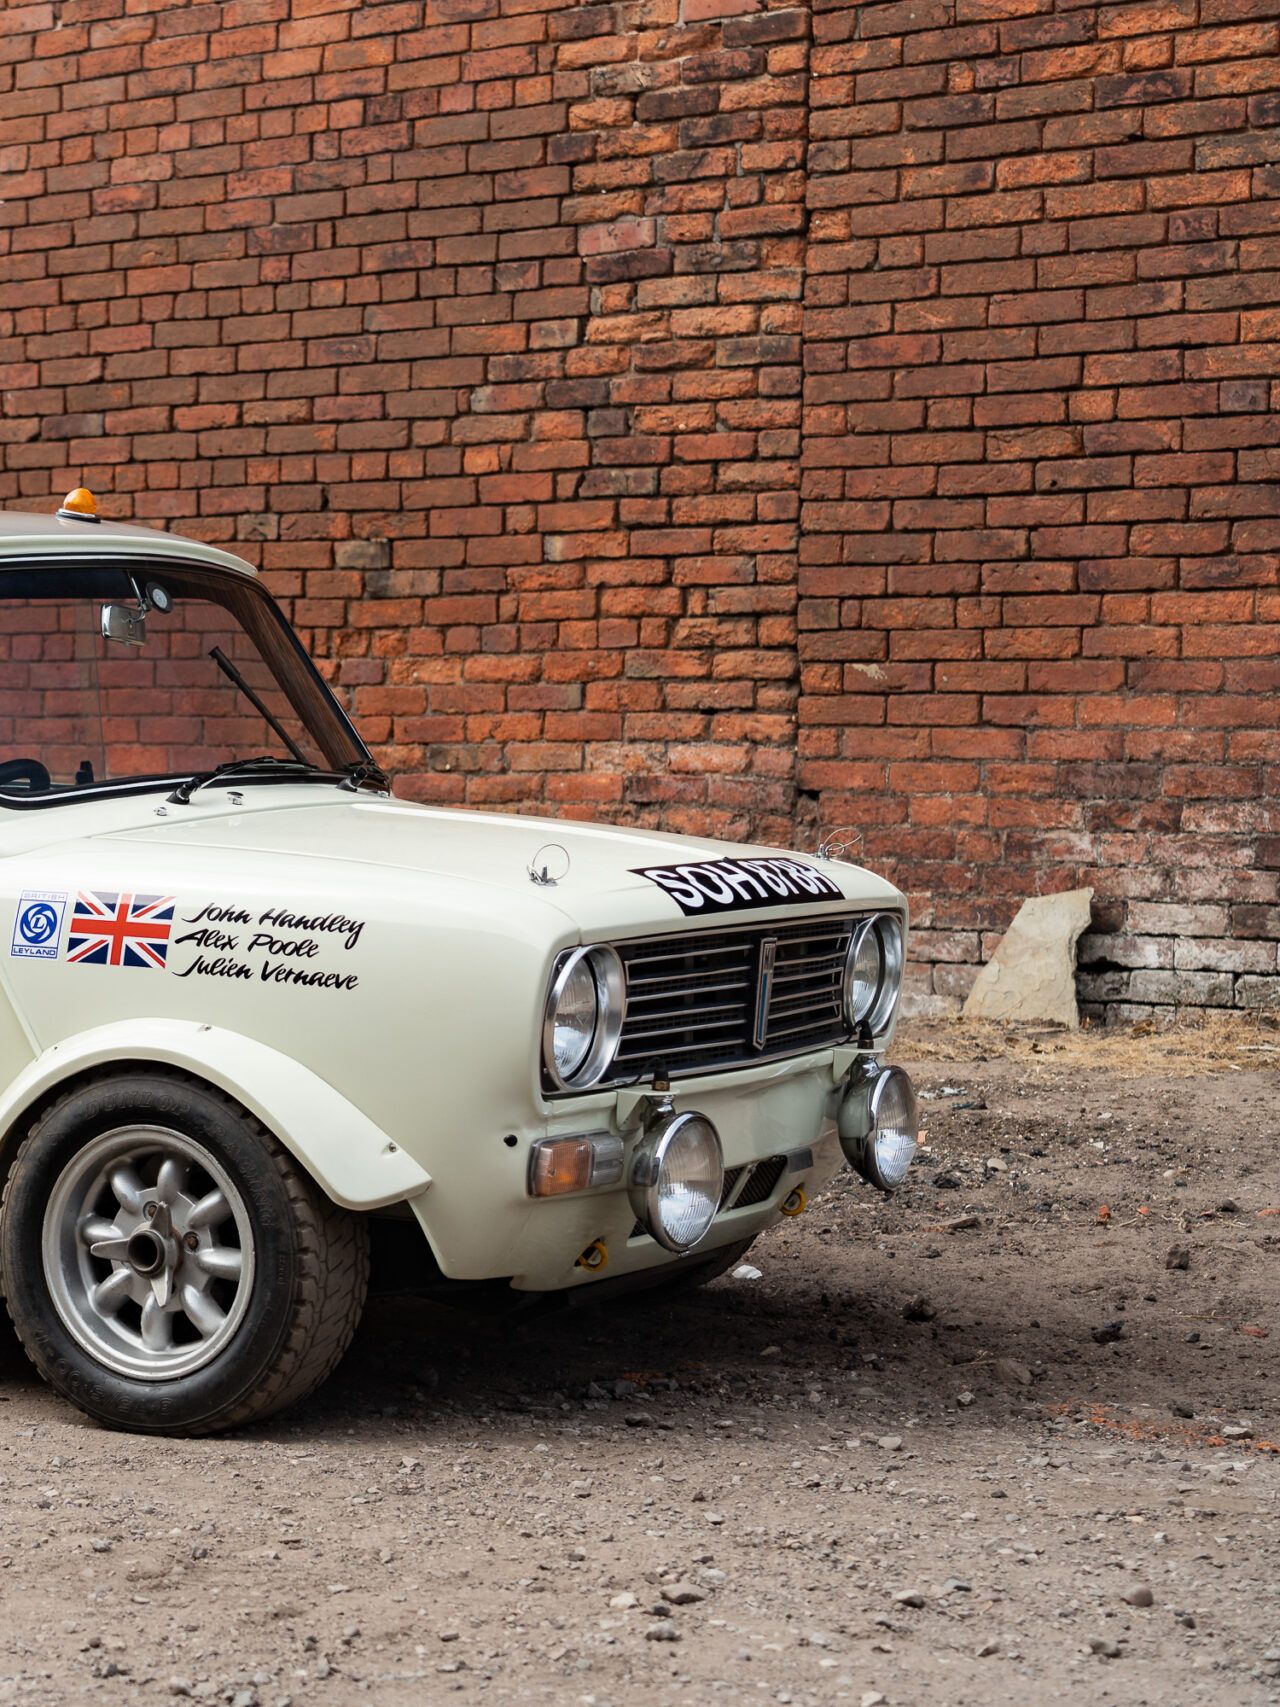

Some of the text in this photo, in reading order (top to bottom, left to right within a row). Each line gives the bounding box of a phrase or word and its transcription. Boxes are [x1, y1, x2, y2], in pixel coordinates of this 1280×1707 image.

[643, 860, 769, 908] SOH
[32, 917, 45, 929] L
[181, 902, 366, 949] John Handley
[13, 947, 56, 956] LEYLAND
[174, 928, 320, 958] Alex Poole
[172, 955, 359, 990] Julien Vernaeve
[85, 1090, 190, 1120] DUNLOP
